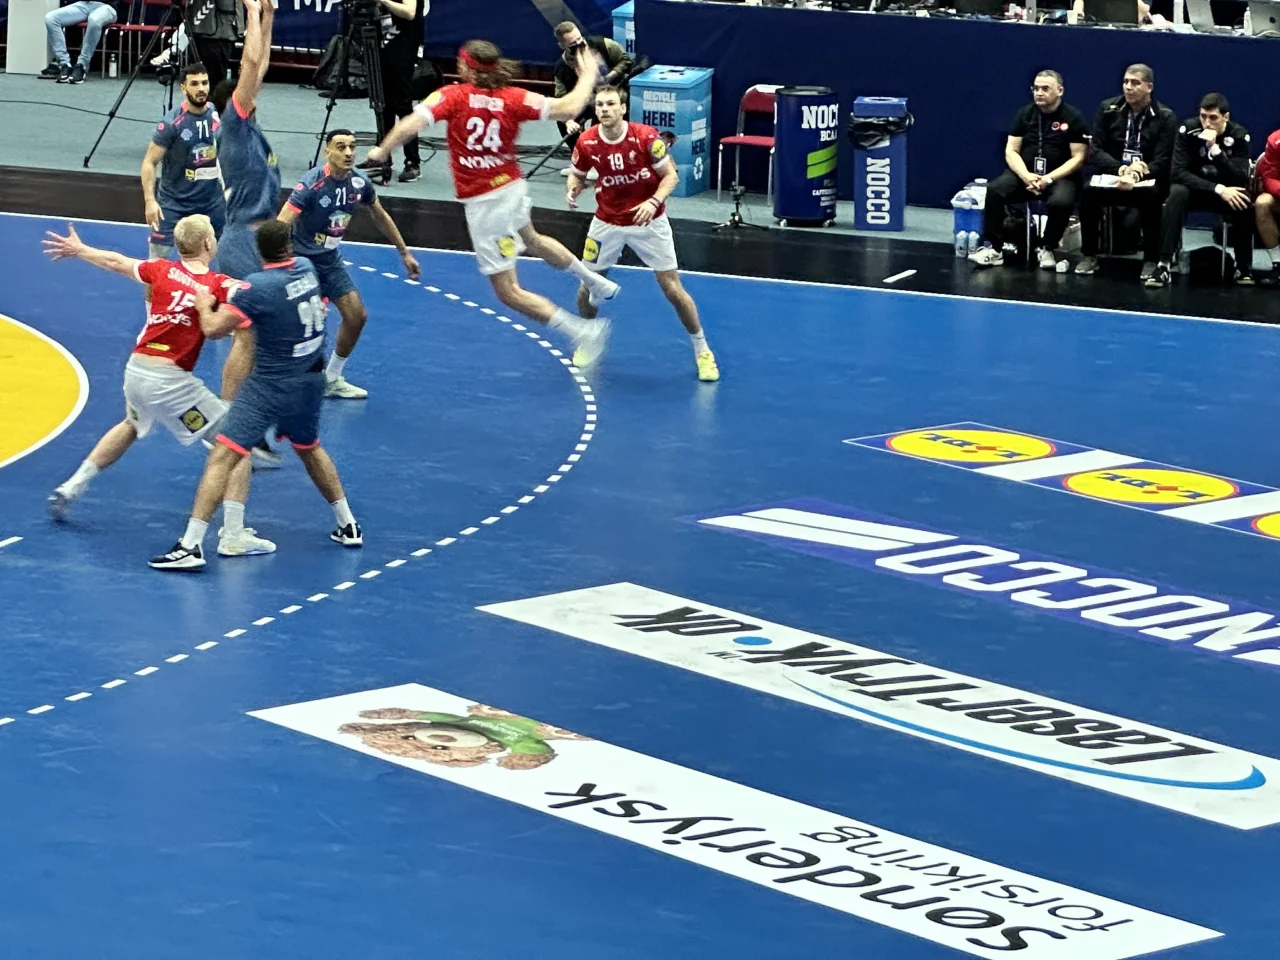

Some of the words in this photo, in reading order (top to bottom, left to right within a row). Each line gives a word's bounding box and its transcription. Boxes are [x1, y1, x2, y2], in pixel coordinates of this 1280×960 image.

[196, 119, 209, 139] 71
[642, 111, 676, 128] HERE
[466, 116, 503, 153] 24
[607, 153, 624, 170] 19
[335, 186, 347, 206] 21
[866, 157, 891, 225] NOCCO
[166, 289, 197, 312] 15
[544, 782, 1067, 951] Sønderjysk
[799, 825, 1134, 933] forsikring
